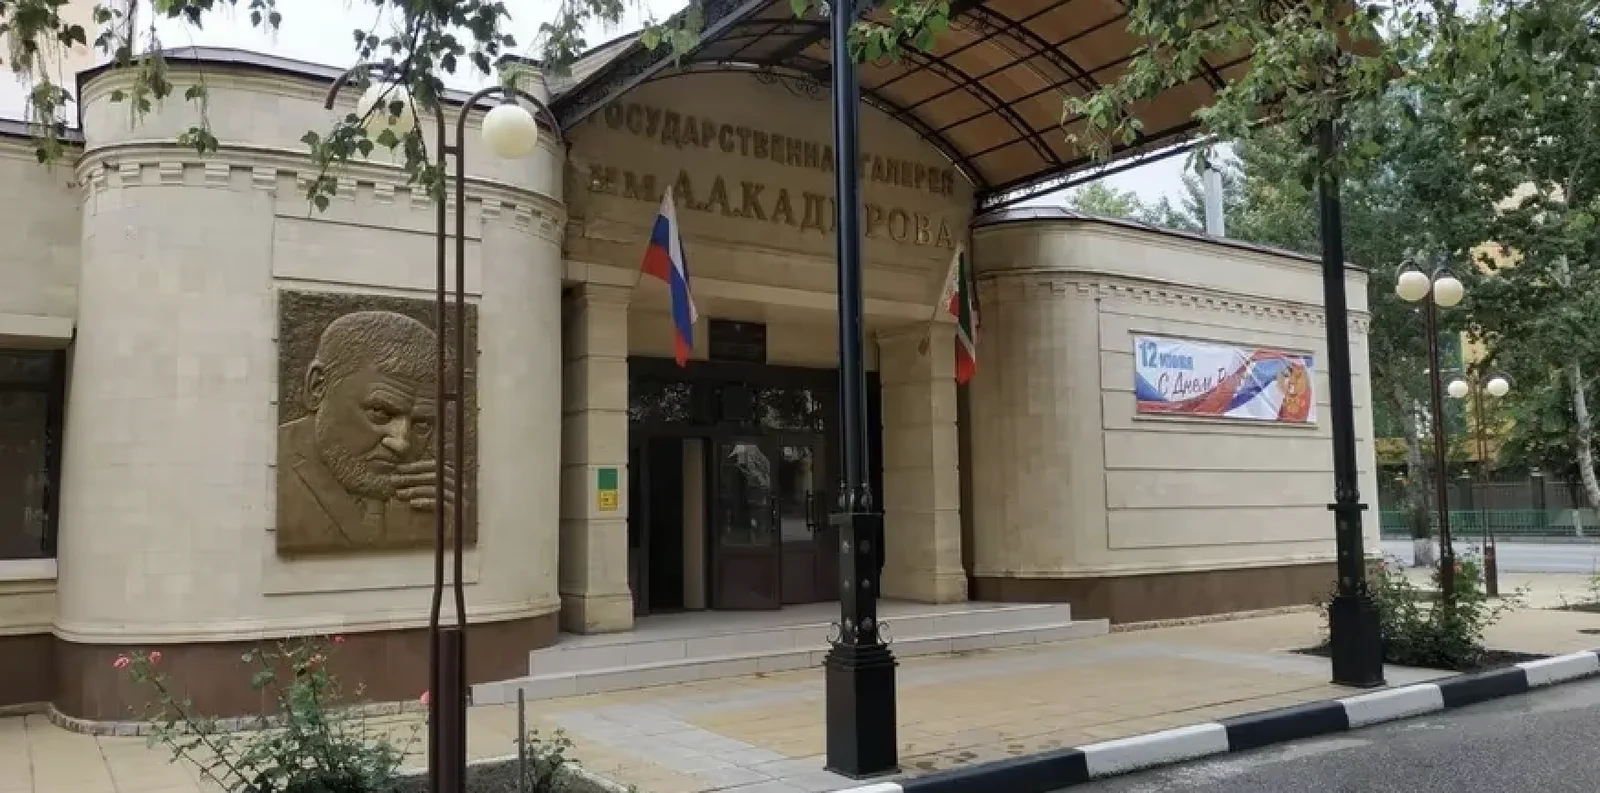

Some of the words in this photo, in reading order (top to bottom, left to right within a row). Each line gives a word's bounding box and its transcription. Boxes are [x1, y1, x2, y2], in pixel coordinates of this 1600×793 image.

[588, 101, 834, 173] ОСУДАРСТВЕННА
[673, 167, 955, 250] А.А.КАДРОВА
[1138, 341, 1157, 368] 12
